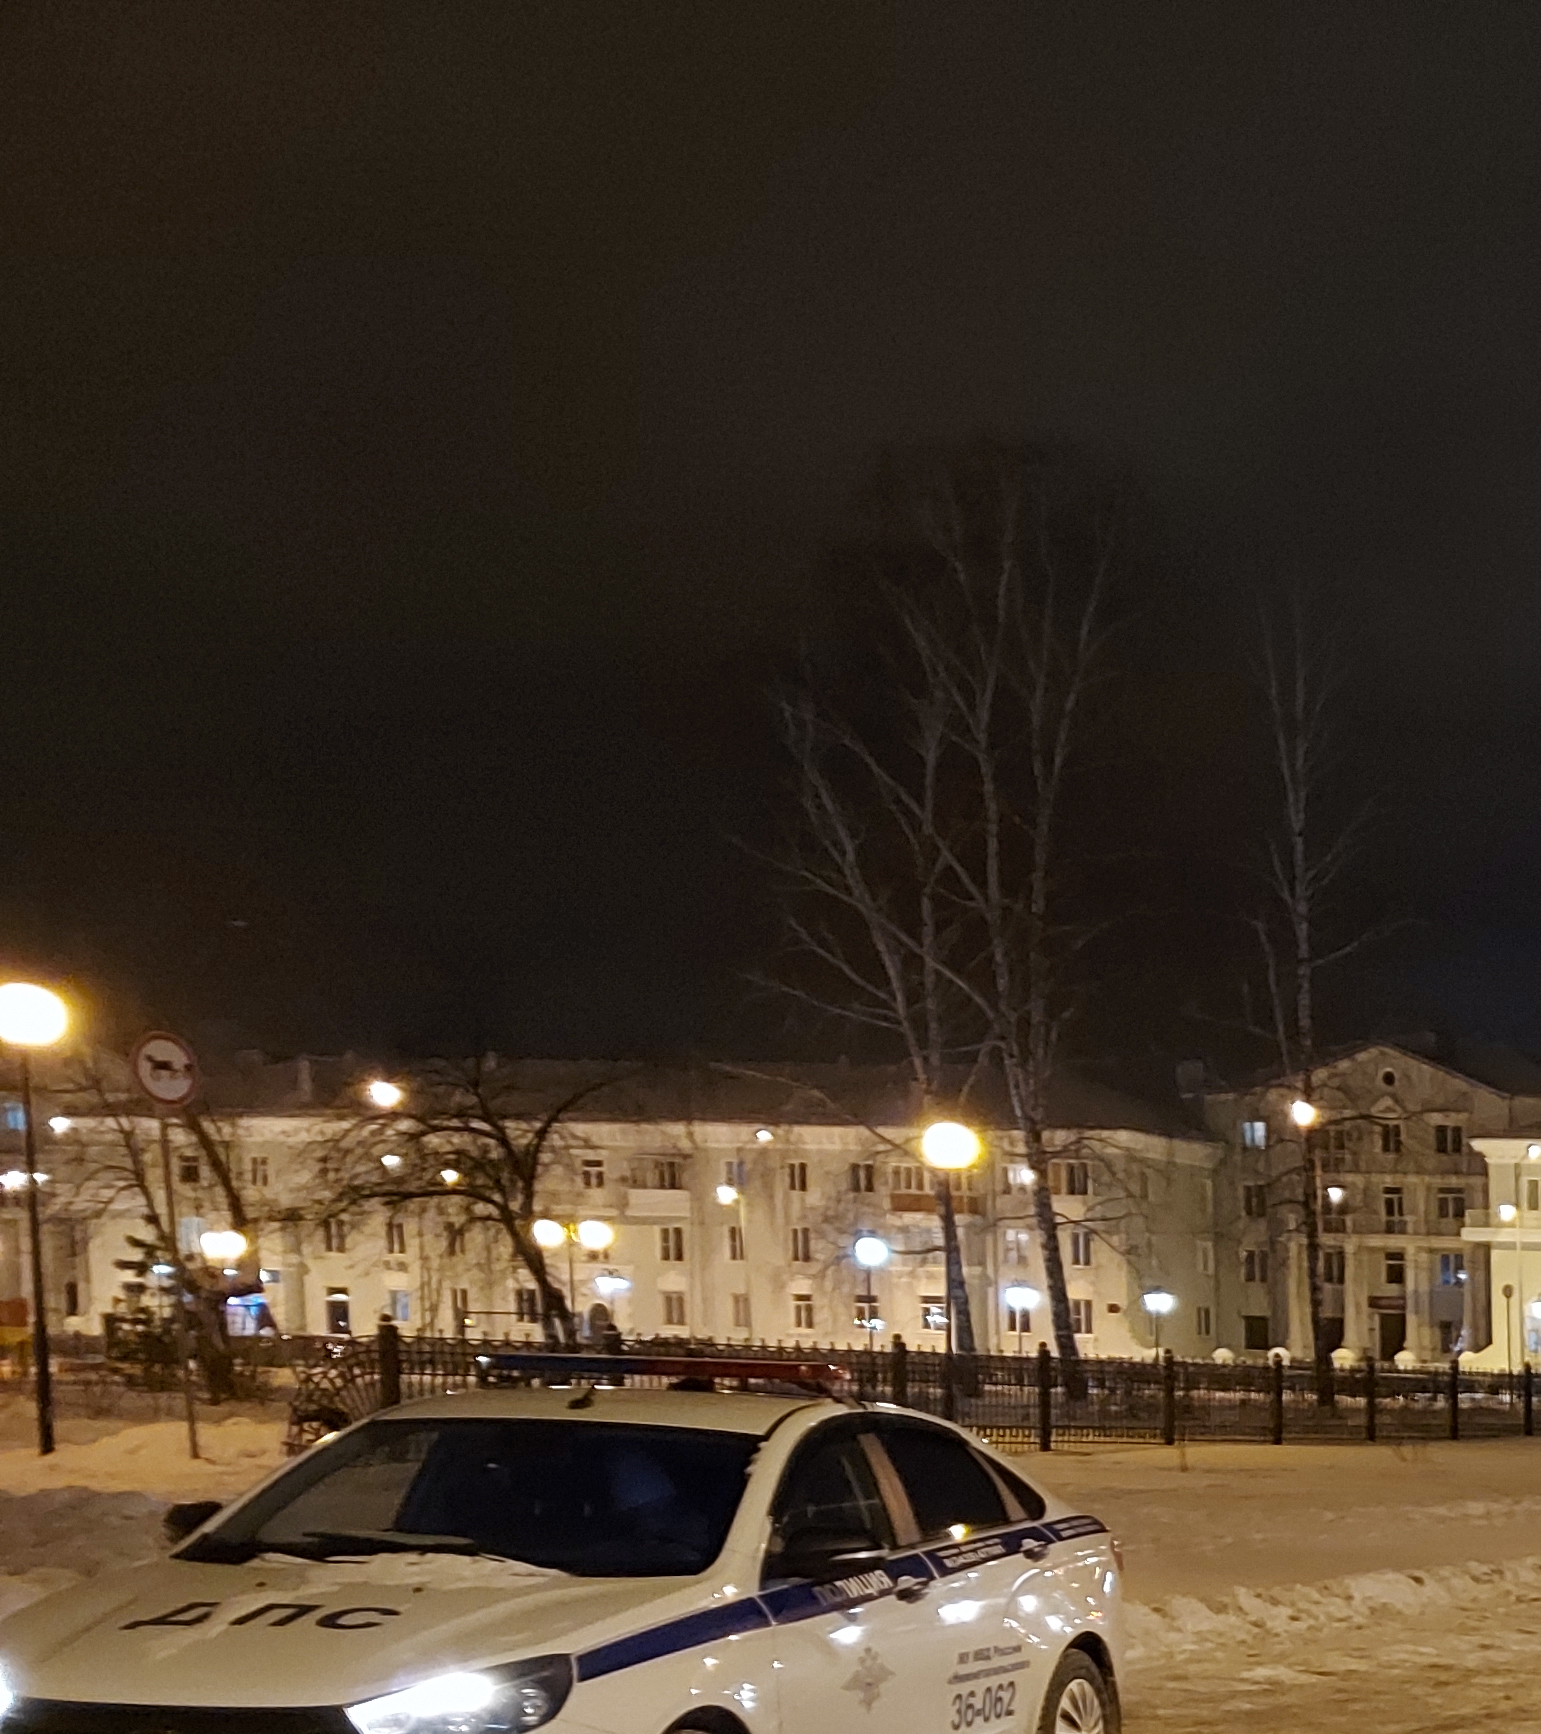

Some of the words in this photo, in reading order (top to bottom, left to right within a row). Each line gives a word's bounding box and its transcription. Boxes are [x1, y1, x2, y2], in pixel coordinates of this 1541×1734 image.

[811, 1570, 894, 1606] ПОЛИЦИЯ
[118, 1601, 402, 1630] ДПС
[951, 1680, 1015, 1731] 36-062
